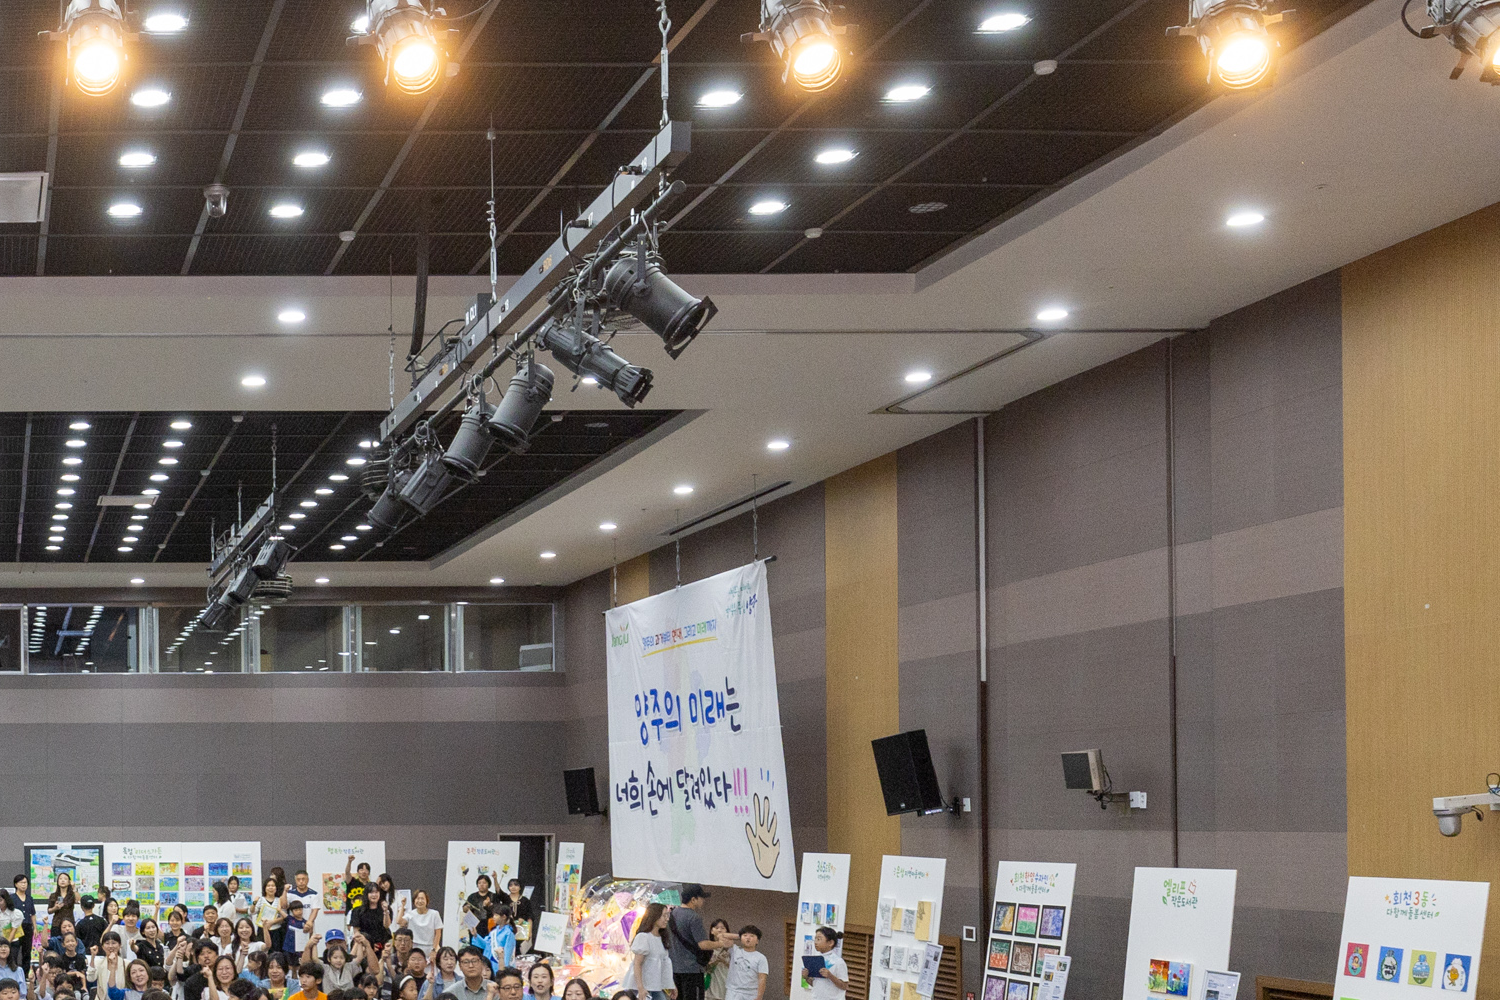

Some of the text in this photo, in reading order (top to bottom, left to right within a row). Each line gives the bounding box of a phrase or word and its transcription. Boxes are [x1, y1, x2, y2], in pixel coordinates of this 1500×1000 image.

[634, 676, 742, 746] 양주의 미래는
[616, 769, 644, 811] 너희
[646, 760, 674, 816] 손에
[1163, 878, 1186, 897] 엘리프
[1171, 895, 1198, 909] 작은도서관
[1386, 906, 1434, 920] 다함께돌봄센터
